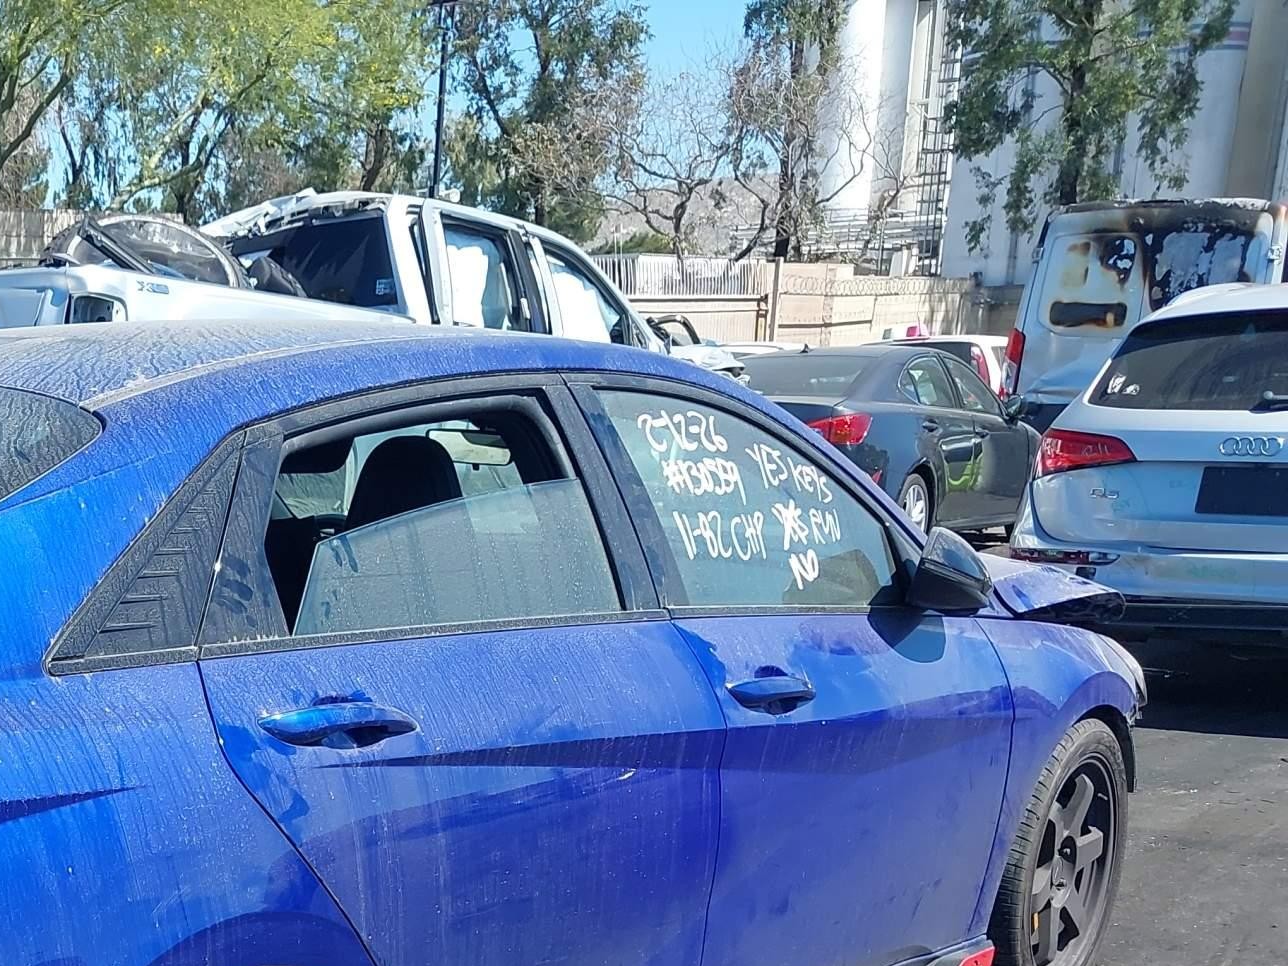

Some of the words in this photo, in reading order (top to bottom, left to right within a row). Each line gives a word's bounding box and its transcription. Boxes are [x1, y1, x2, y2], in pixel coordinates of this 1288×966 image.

[745, 443, 788, 490] YES
[730, 511, 768, 561] CHP
[808, 507, 841, 545] RUN
[788, 548, 820, 591] NO
